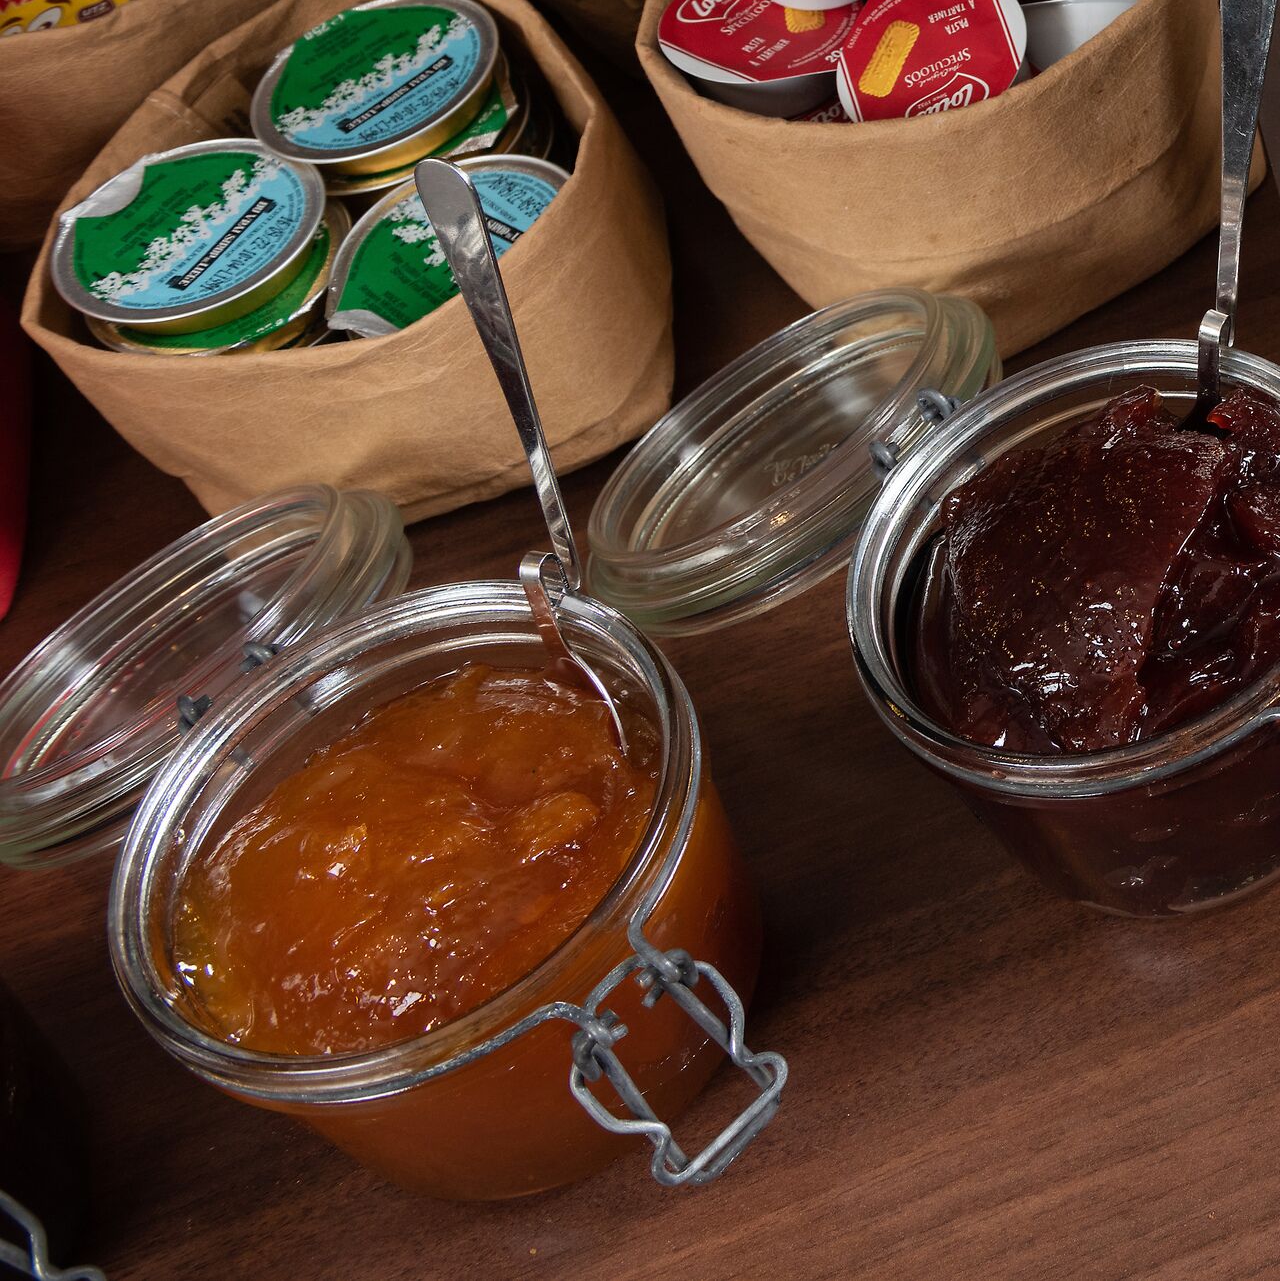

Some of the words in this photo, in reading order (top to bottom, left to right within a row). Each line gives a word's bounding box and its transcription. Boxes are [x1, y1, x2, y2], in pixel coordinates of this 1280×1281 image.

[927, 2, 967, 24] TARTINER
[944, 17, 970, 36] PASTA
[741, 36, 767, 54] PASTA
[757, 38, 791, 63] TARTINER
[231, 212, 258, 234] VRAI
[209, 232, 237, 260] SIROP
[178, 258, 210, 287] LIEGE
